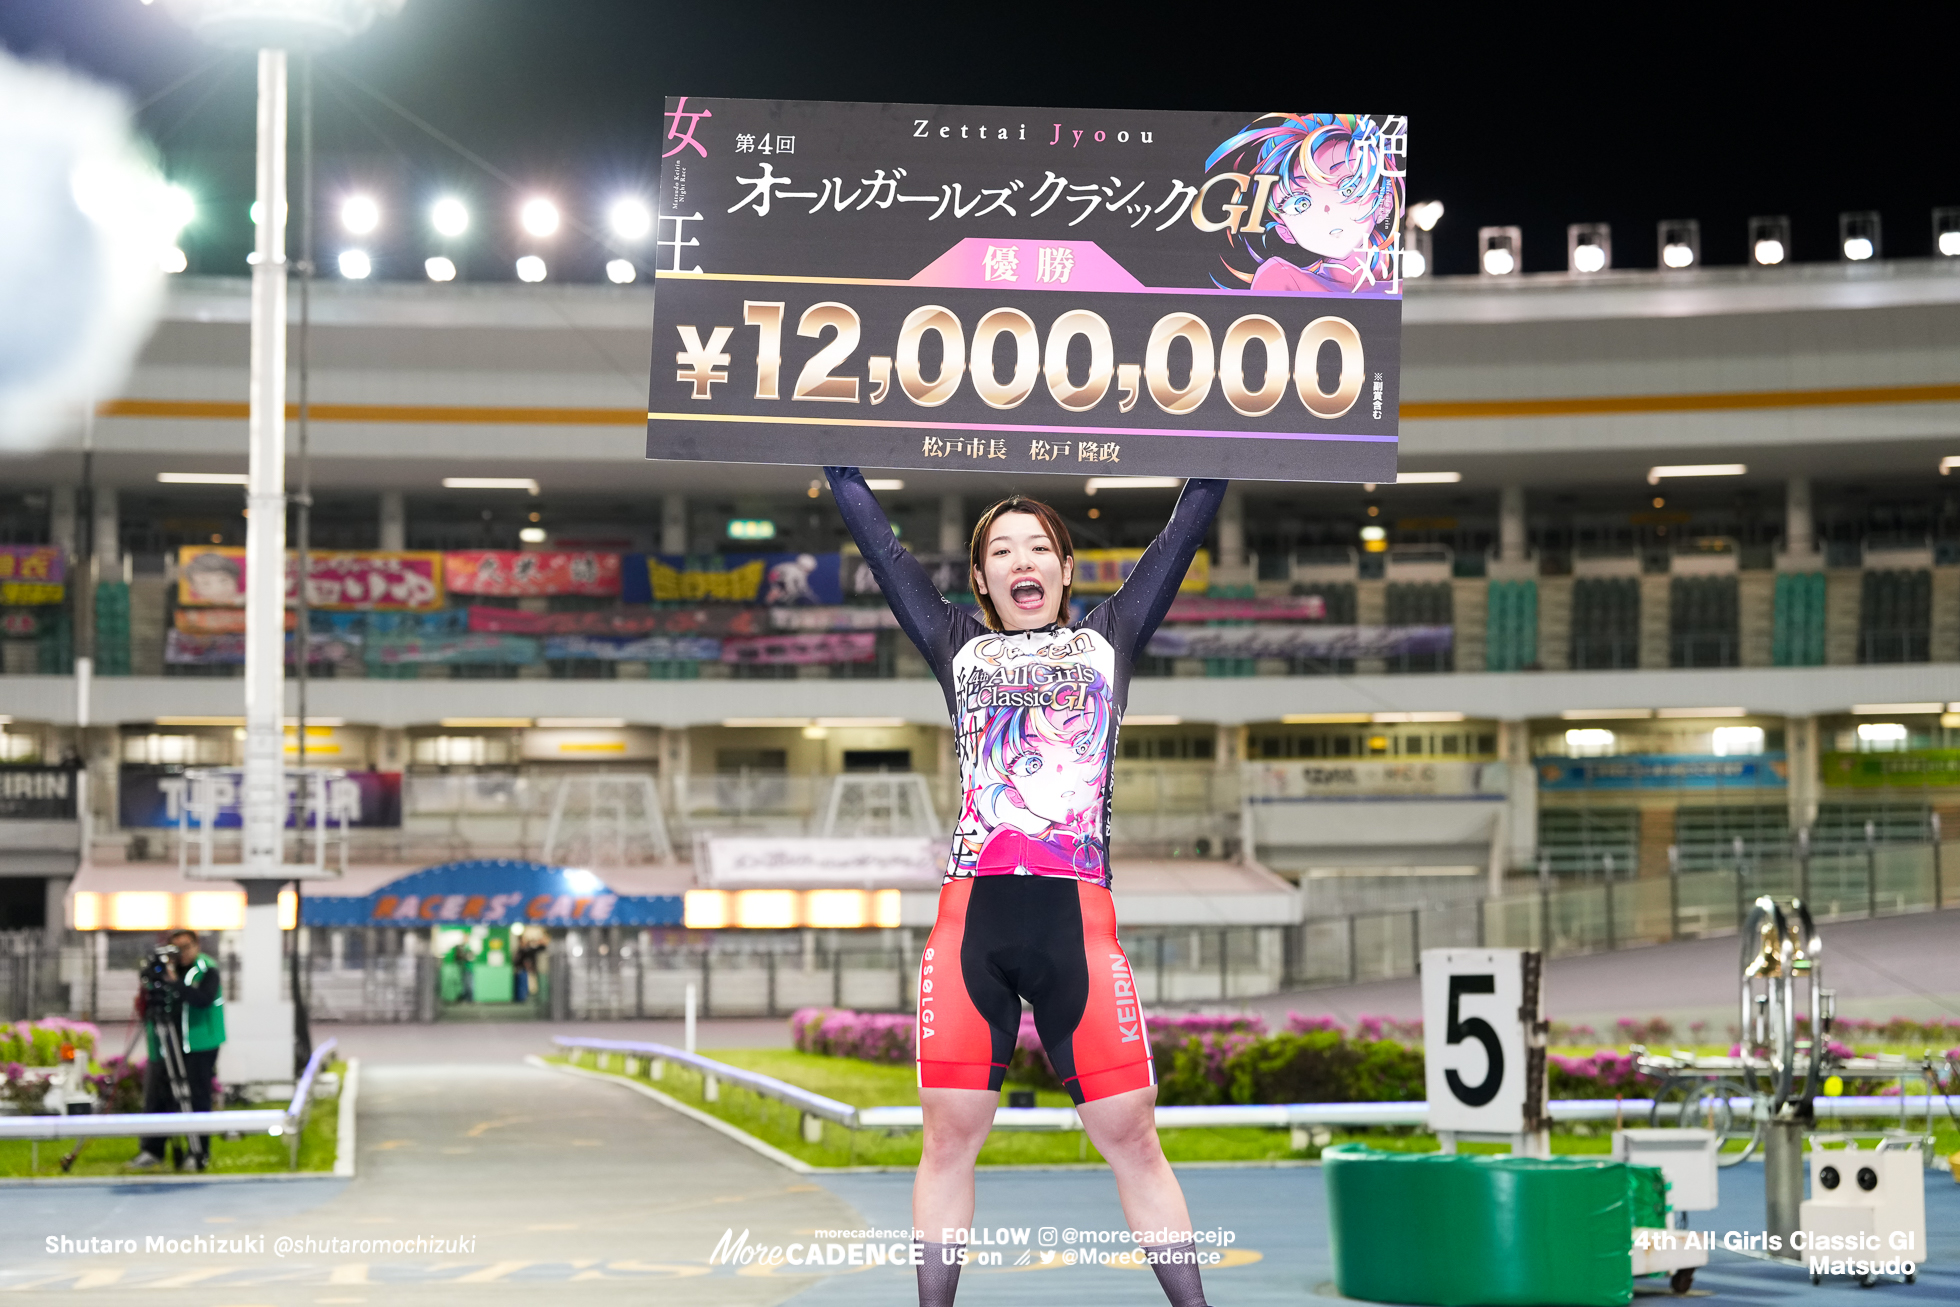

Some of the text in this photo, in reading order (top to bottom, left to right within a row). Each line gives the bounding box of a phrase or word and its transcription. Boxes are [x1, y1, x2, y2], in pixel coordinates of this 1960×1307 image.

[734, 133, 796, 155] 第4回
[913, 119, 1153, 148] Zettai Jyoou
[981, 245, 1075, 285] 優勝
[676, 300, 1366, 419] ¥12,000,000
[922, 436, 1008, 460] 松戸市長
[985, 666, 1029, 687] All
[1031, 663, 1095, 685] Girls
[0, 771, 69, 800] IRIN
[1108, 953, 1141, 1044] KEIRIN
[1443, 973, 1505, 1107] 5
